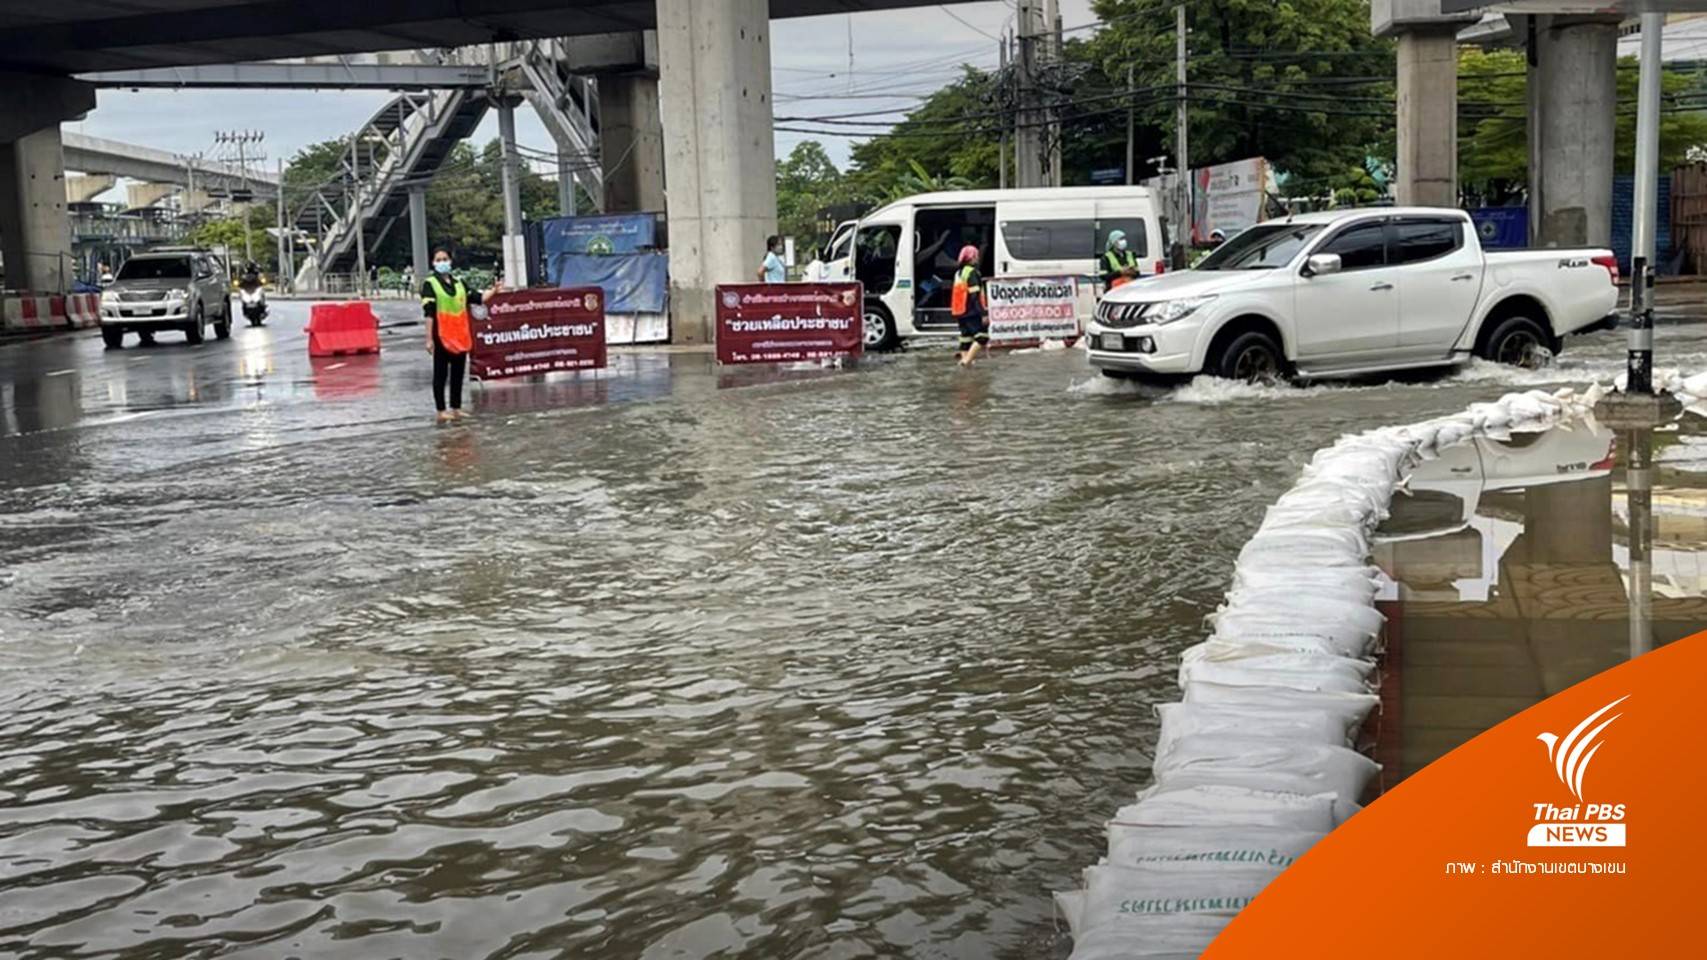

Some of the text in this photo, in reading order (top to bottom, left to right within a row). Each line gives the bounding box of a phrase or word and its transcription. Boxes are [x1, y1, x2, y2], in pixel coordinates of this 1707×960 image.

[991, 282, 1072, 303] ปิดจุดกลับรถเวลา
